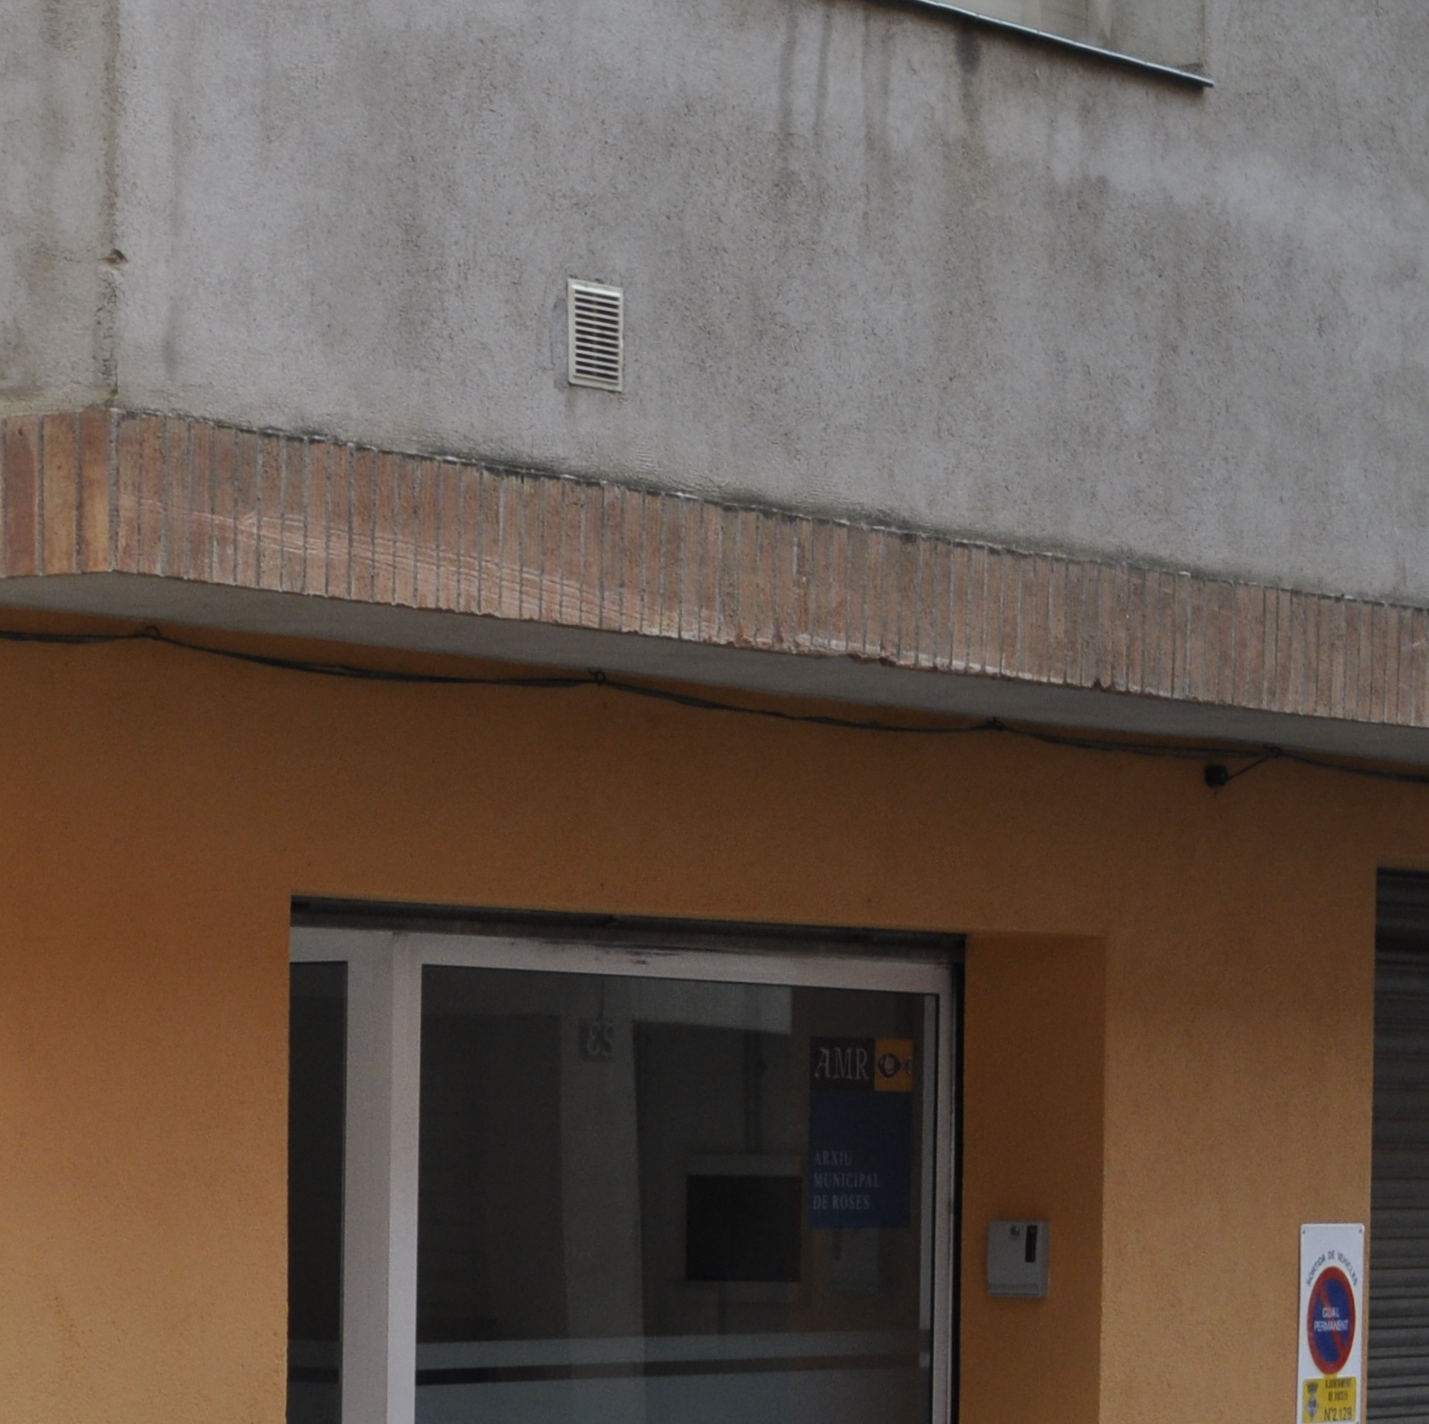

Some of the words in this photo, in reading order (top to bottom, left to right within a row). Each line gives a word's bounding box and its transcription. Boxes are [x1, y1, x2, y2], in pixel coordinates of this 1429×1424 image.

[814, 1046, 870, 1081] AMR
[813, 1150, 853, 1166] ARXIU
[813, 1172, 881, 1188] MUNICIPAL
[812, 1194, 829, 1210] DE
[831, 1194, 871, 1210] ROSES
[1321, 1306, 1340, 1318] GUAL
[1313, 1319, 1349, 1332] PERMANENT
